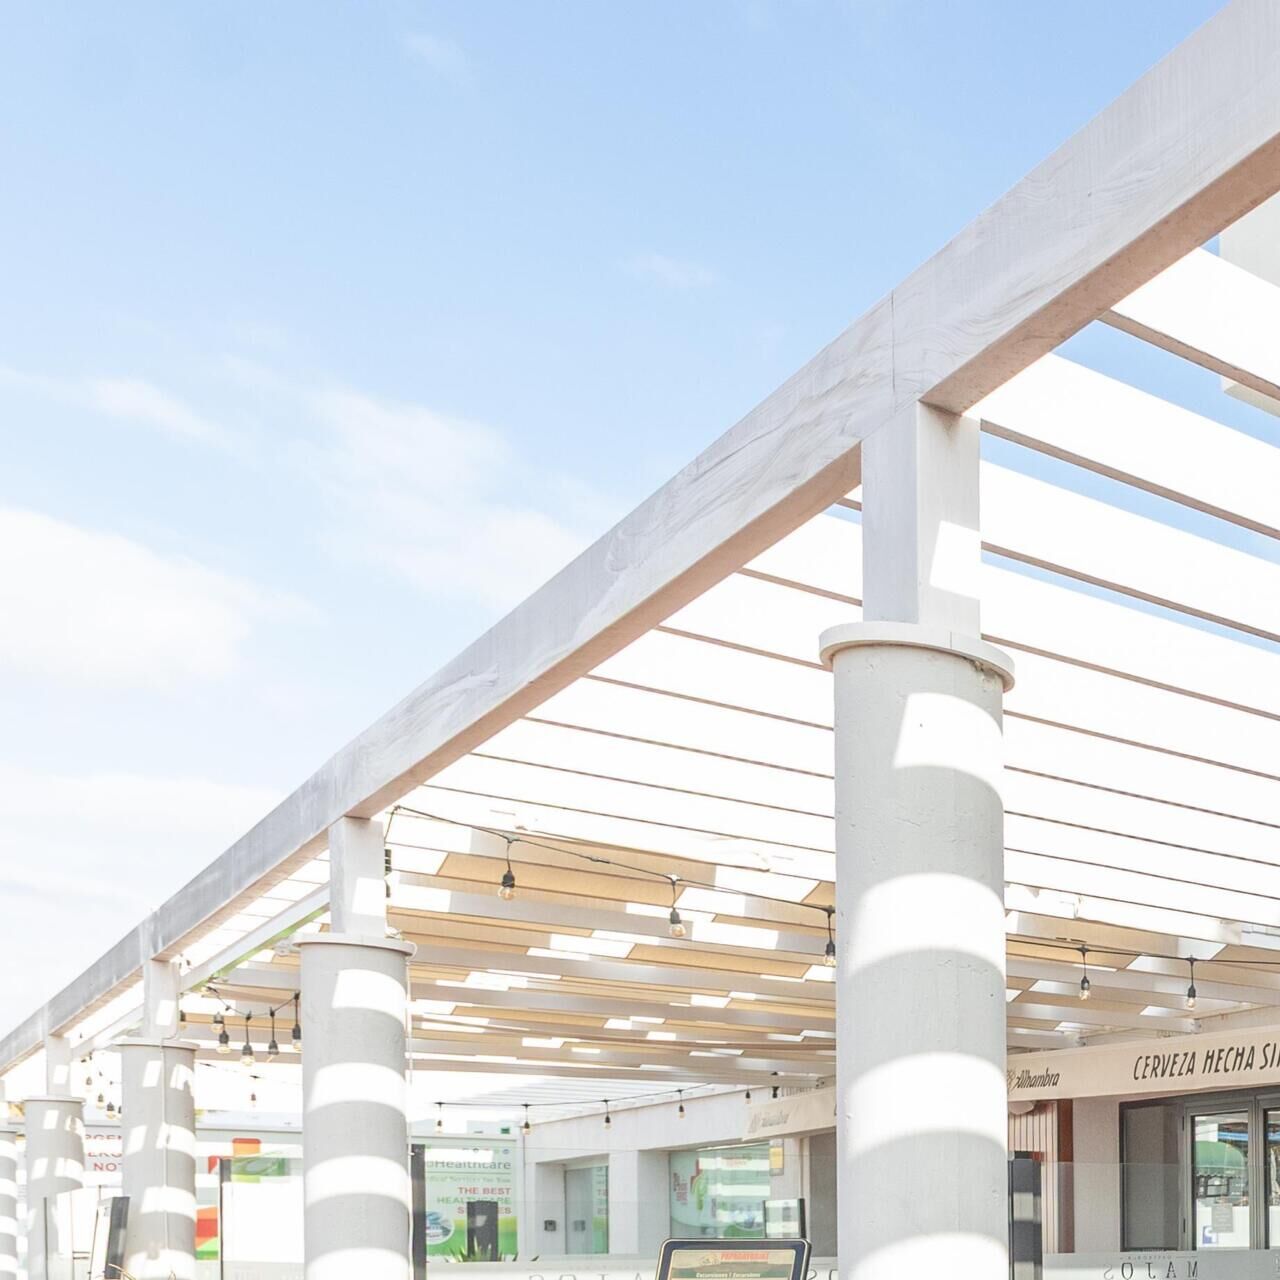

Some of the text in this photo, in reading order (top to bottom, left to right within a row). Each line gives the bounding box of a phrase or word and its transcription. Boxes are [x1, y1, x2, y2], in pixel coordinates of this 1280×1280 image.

[1133, 1051, 1196, 1081] CERVEZA
[1202, 1046, 1255, 1074] HECHA
[1016, 1067, 1060, 1089] Alhambra
[458, 1186, 511, 1195] THE BEST
